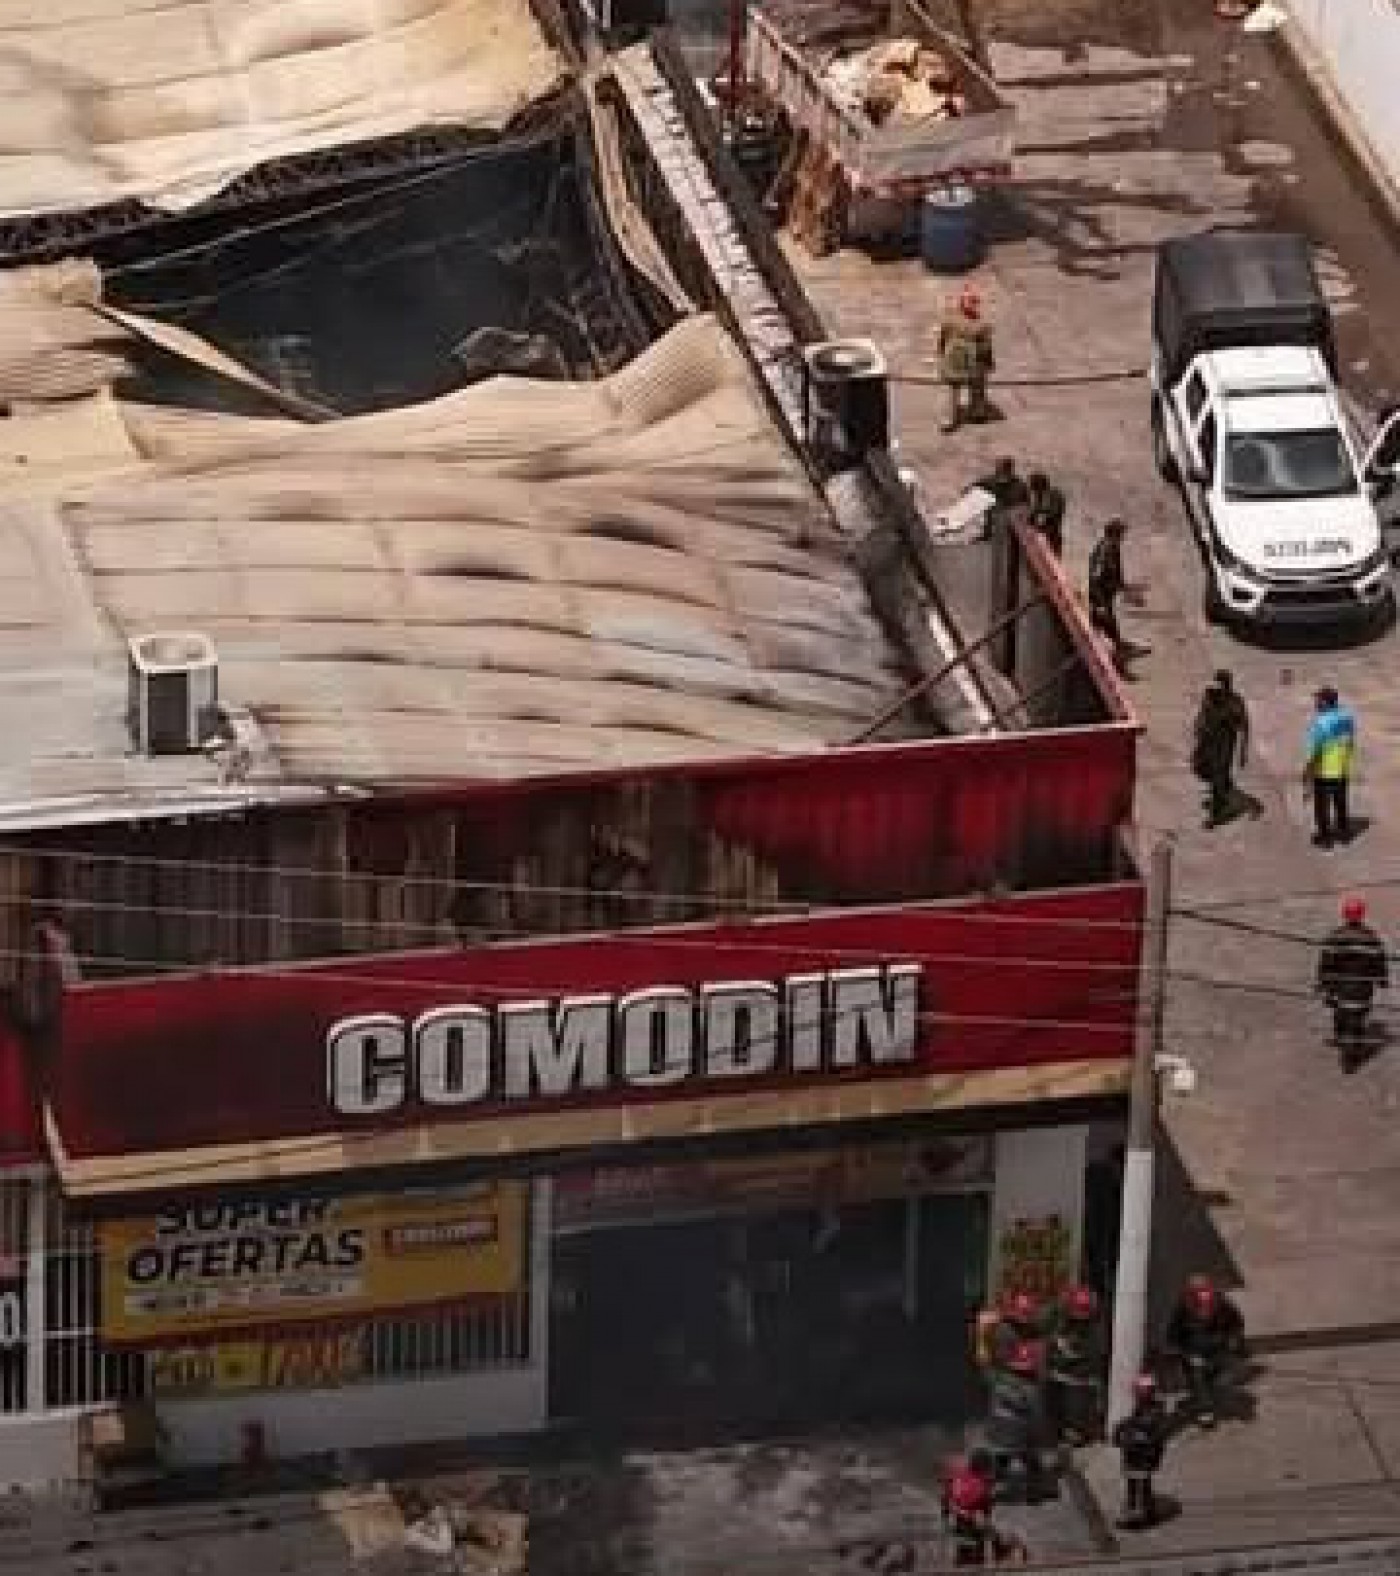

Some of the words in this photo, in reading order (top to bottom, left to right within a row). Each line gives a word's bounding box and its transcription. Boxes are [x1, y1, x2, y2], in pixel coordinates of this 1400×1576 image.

[326, 964, 922, 1114] COMODIN
[157, 1198, 330, 1235] SUPER
[128, 1230, 367, 1281] OFERTAS
